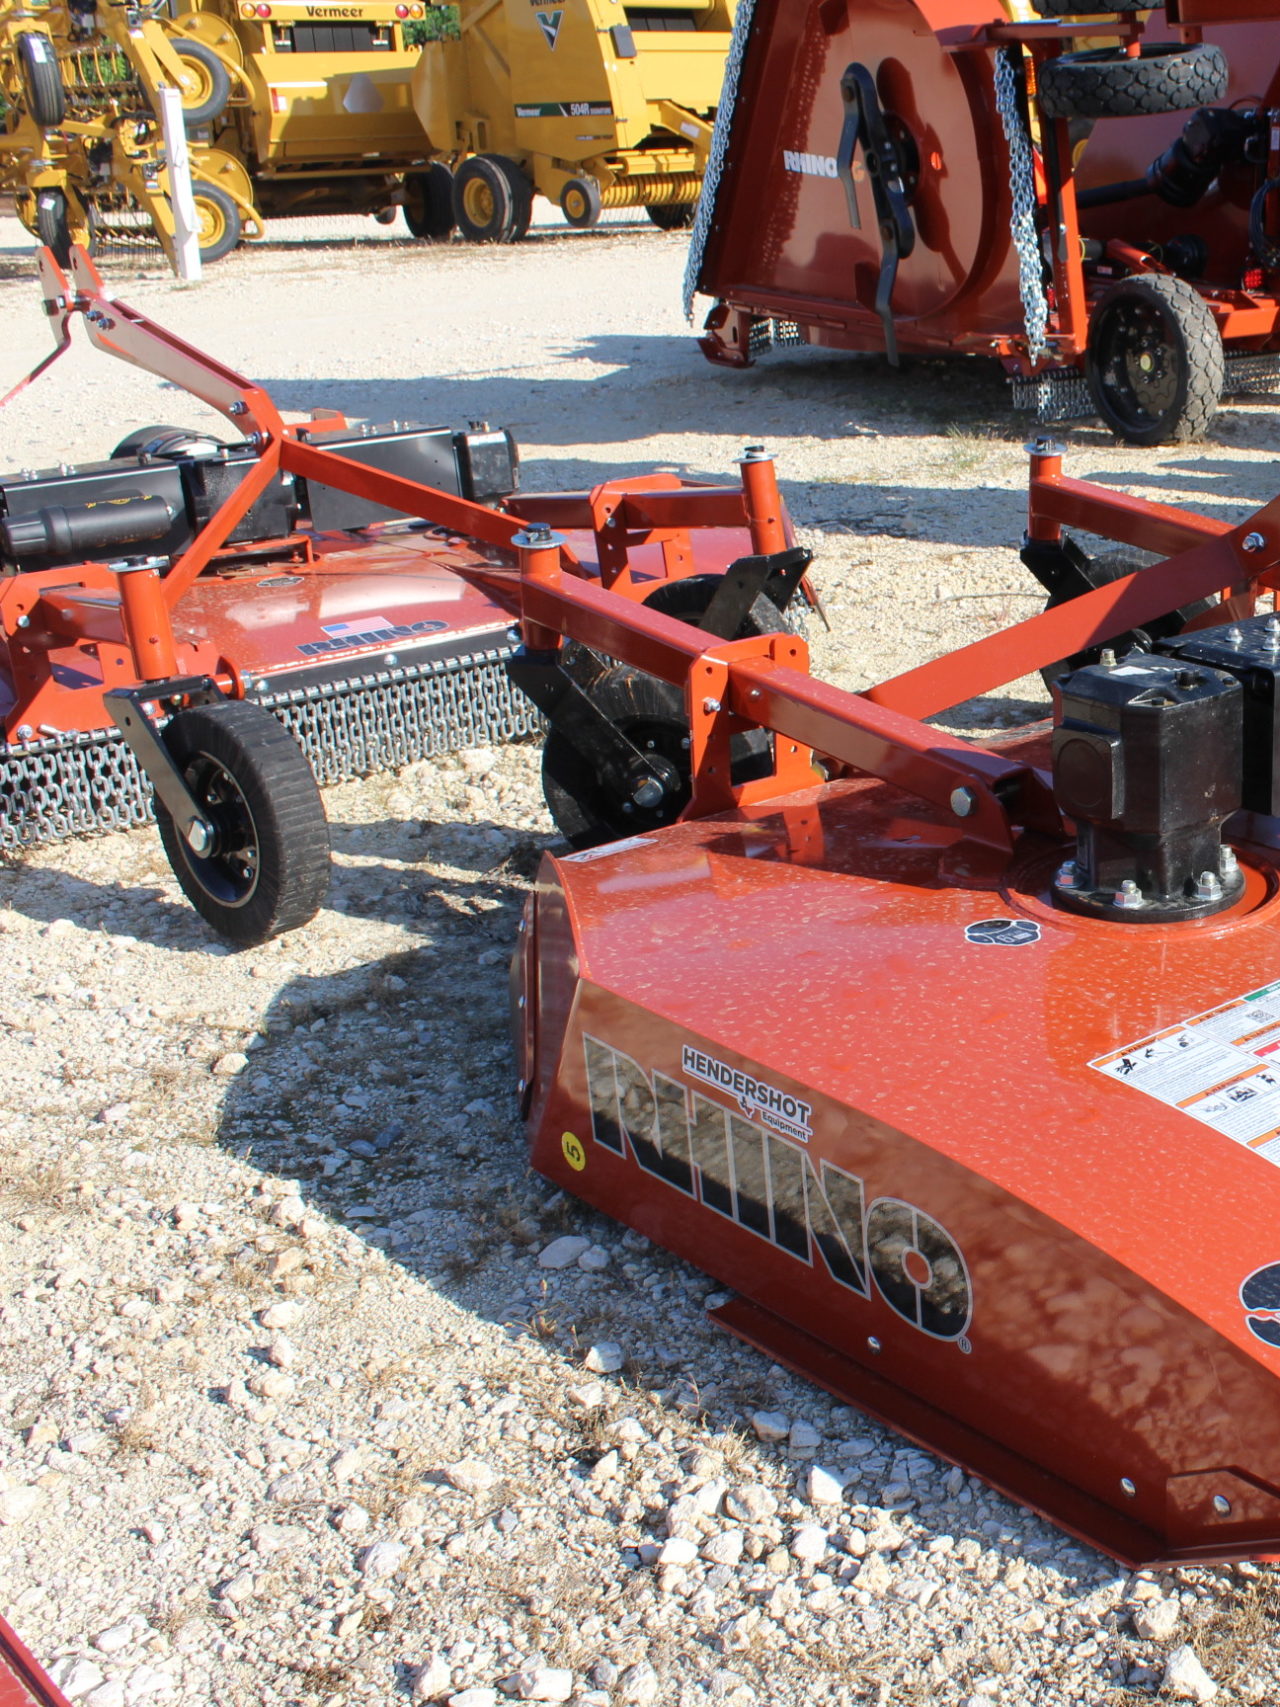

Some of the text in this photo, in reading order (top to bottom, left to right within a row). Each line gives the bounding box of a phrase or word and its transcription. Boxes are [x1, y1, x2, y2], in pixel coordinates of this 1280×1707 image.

[305, 5, 363, 17] Vermeer
[570, 103, 589, 116] 504R
[296, 620, 449, 656] RHINO
[684, 1047, 810, 1123] HENDERSHOT
[1209, 1075, 1244, 1092] WARNING
[762, 1111, 807, 1140] Equipment
[566, 1141, 580, 1162] 5
[582, 1031, 973, 1343] RHINO
